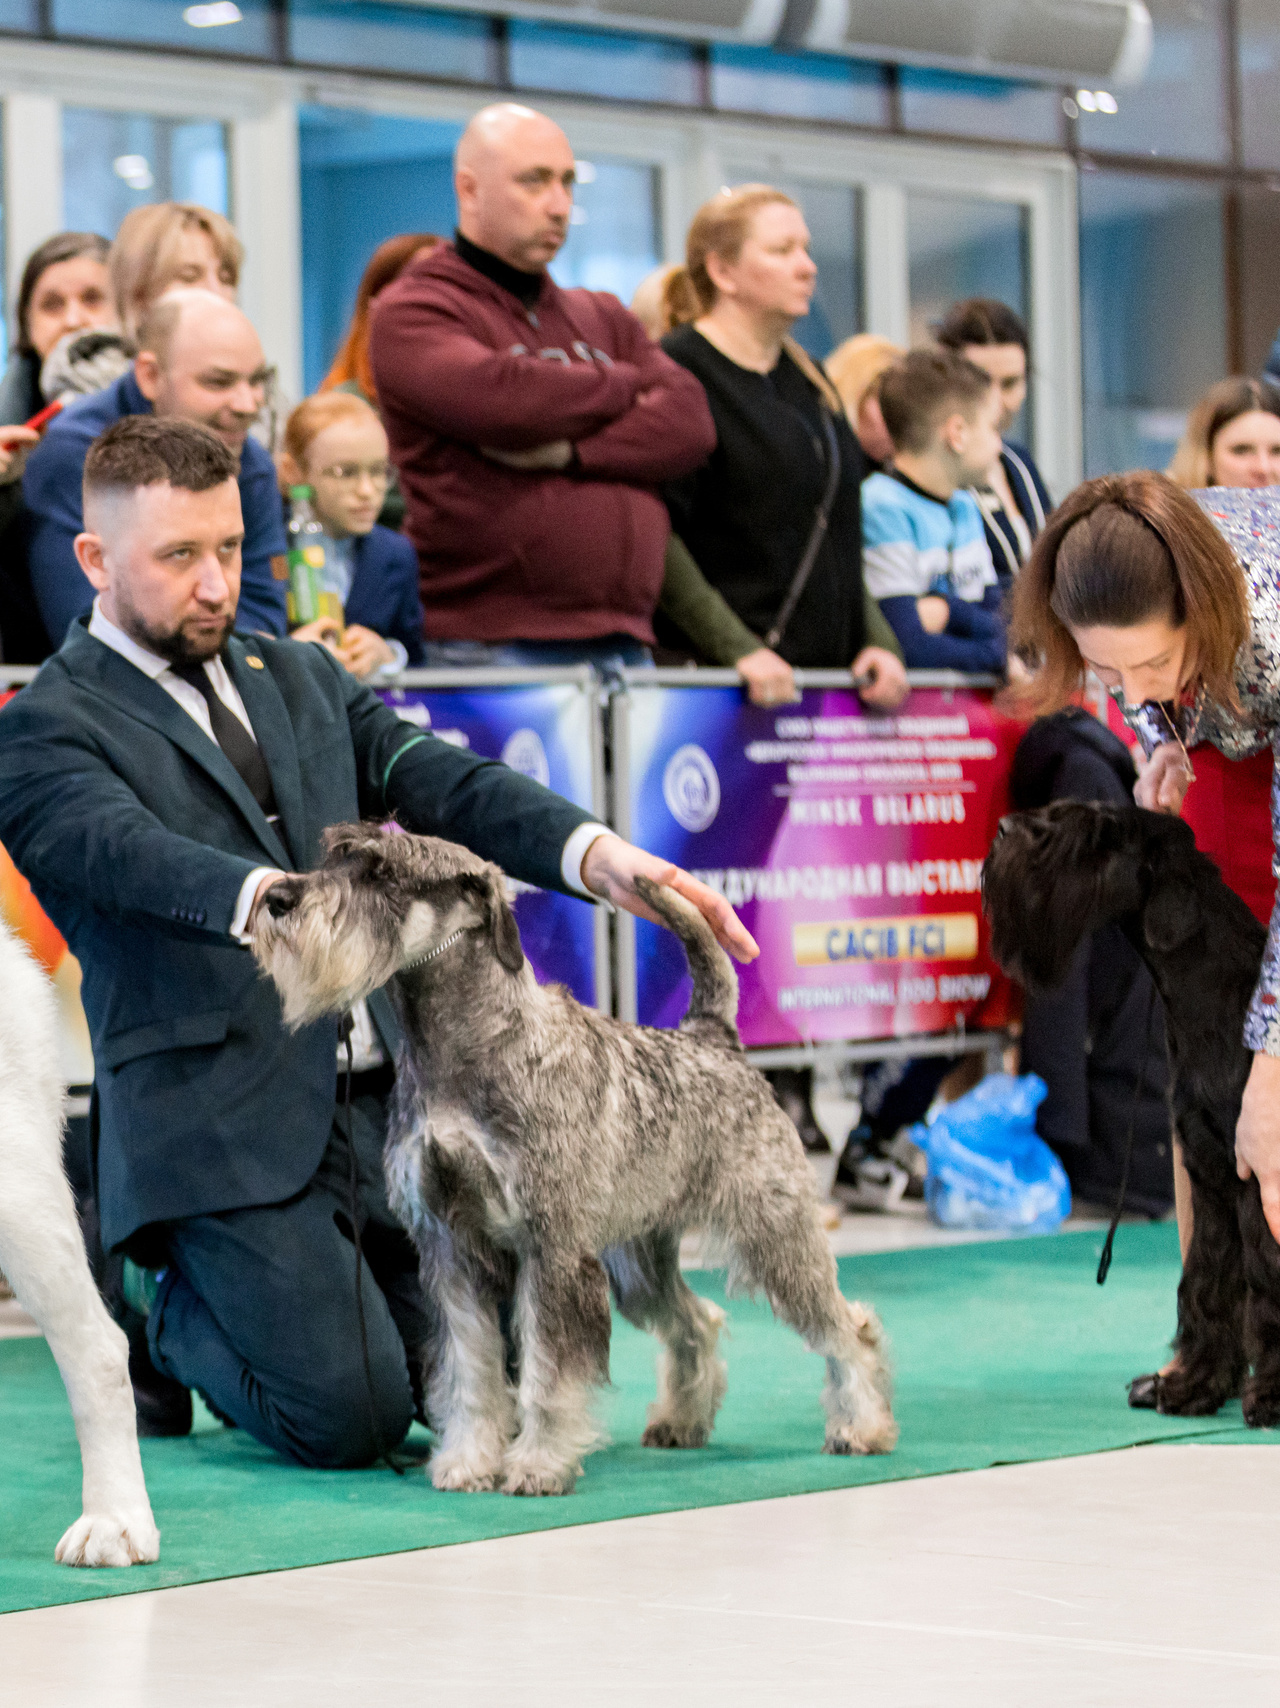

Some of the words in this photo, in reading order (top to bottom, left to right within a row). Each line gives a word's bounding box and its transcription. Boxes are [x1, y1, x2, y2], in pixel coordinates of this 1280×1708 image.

[789, 797, 862, 827] MINSK
[873, 793, 966, 826] BELARUS
[826, 925, 899, 962] CACIB
[909, 922, 947, 957] FCI
[779, 982, 895, 1011] INTERNATIONAL
